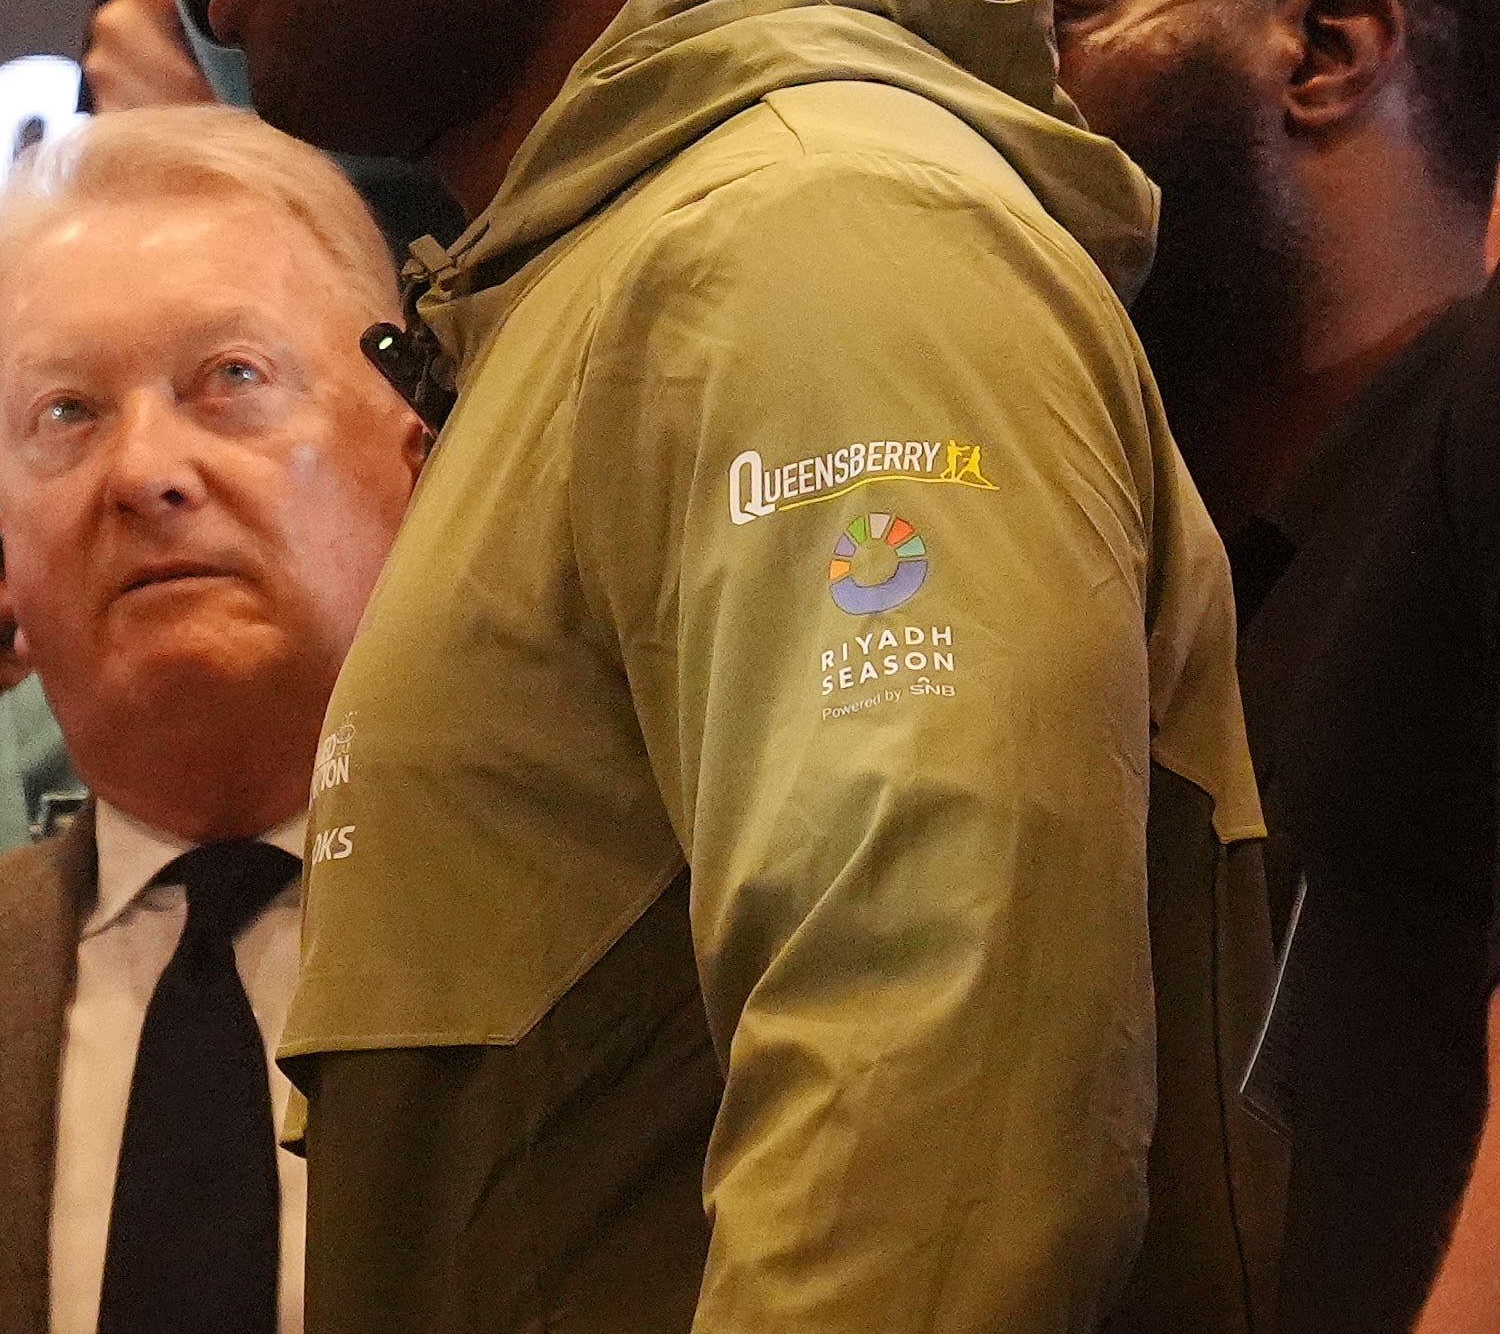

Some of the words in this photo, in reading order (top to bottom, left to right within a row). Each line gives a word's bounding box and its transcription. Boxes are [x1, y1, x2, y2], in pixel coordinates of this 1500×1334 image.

[729, 439, 941, 525] QUEENSBERRY
[821, 625, 952, 672] RIYADH
[821, 651, 954, 696] SEASON
[822, 693, 881, 721] Powered
[884, 689, 902, 702] by
[909, 680, 956, 697] SNB
